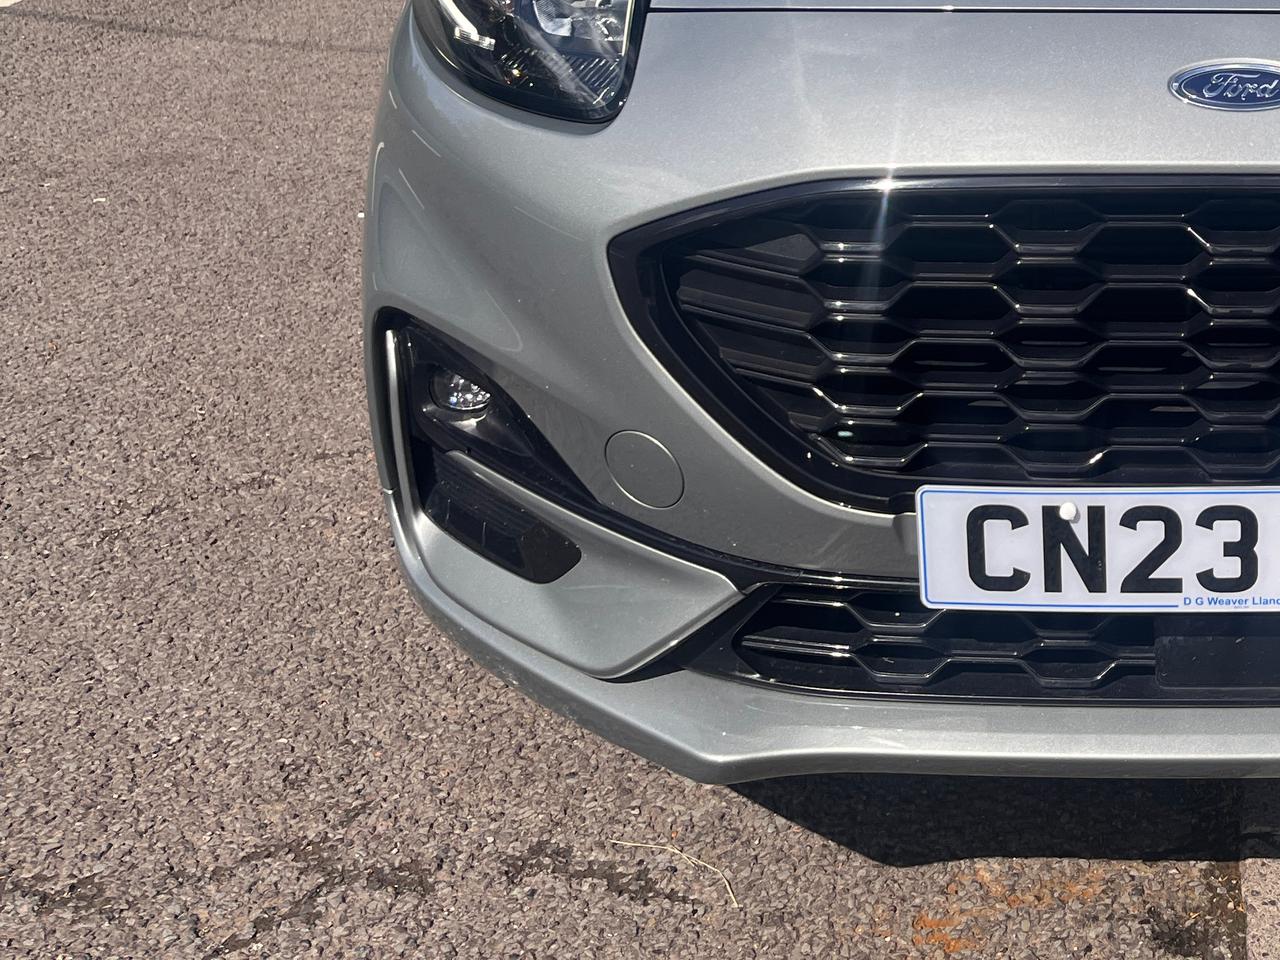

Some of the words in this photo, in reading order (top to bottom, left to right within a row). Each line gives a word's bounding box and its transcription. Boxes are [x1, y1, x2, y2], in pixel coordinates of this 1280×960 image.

[1202, 72, 1280, 101] Ford
[966, 504, 1259, 594] CN23
[1183, 596, 1193, 606] D
[1194, 596, 1205, 606] G
[1206, 596, 1250, 607] Weaver
